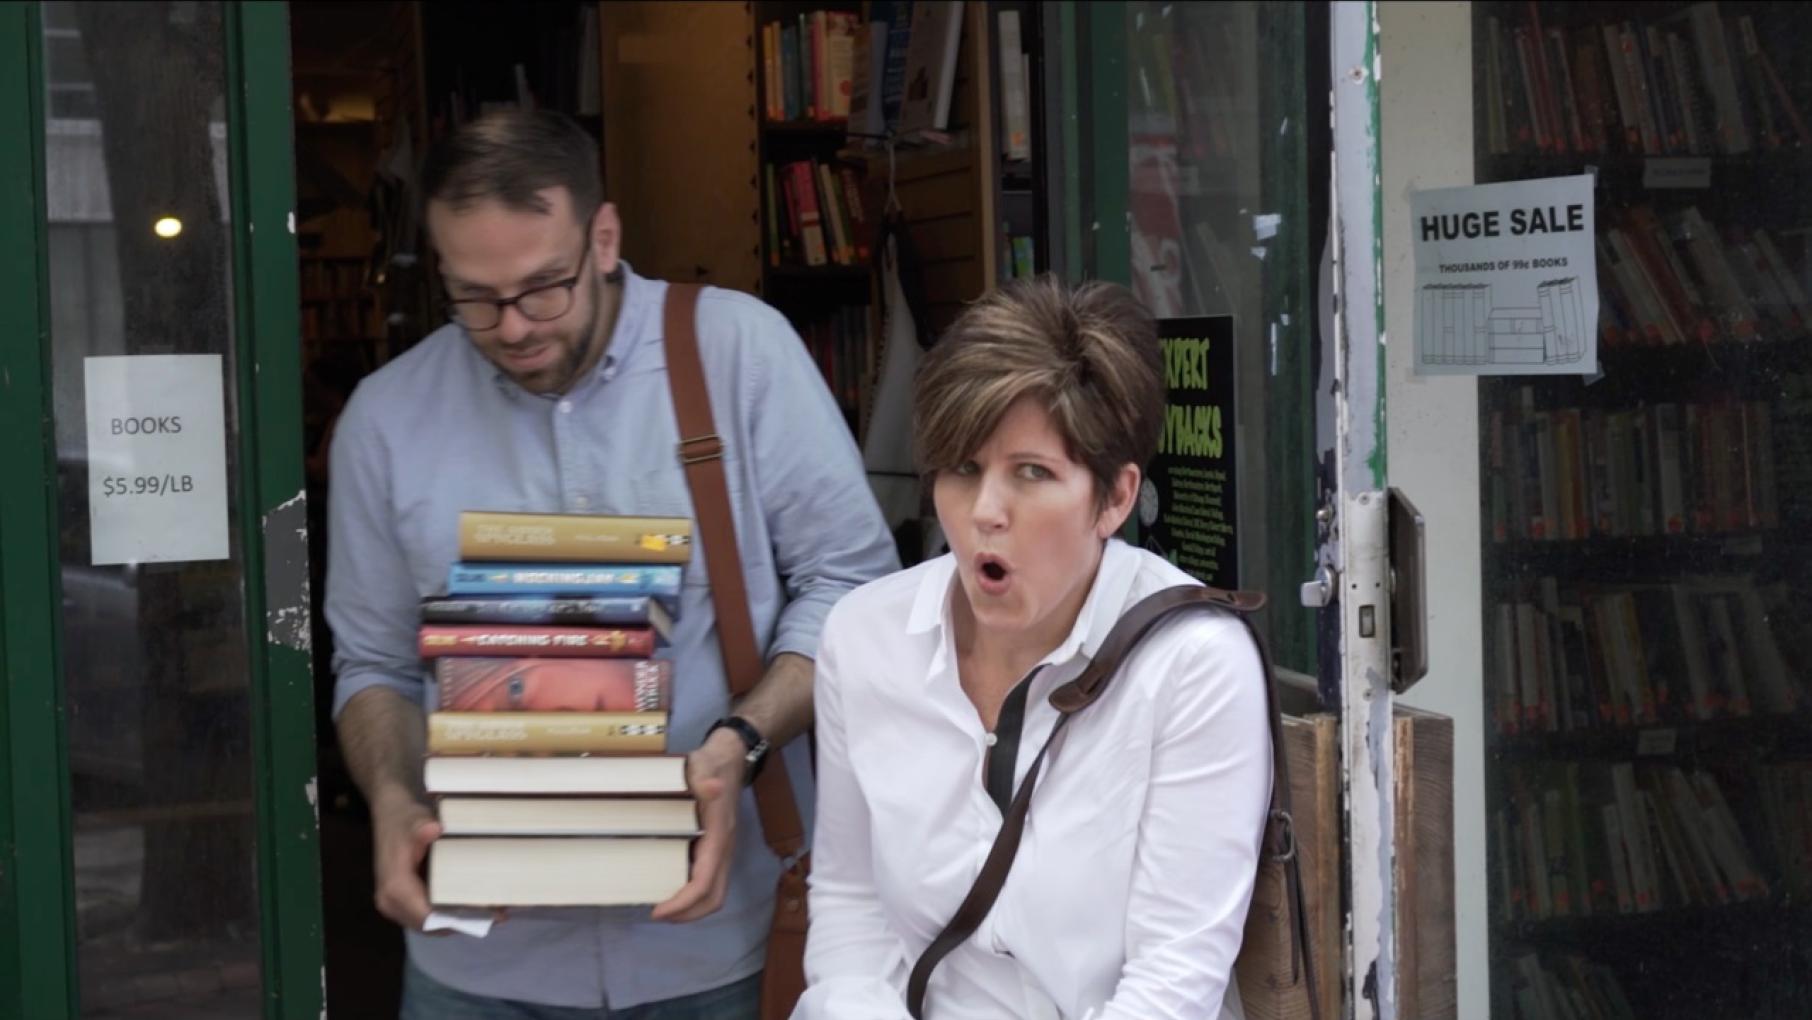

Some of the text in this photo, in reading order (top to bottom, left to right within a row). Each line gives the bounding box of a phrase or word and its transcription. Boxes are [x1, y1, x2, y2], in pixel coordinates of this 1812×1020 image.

[1420, 204, 1585, 242] HUGE SALE
[1438, 261, 1496, 274] THOUSANDS
[1499, 260, 1510, 271] OF
[1532, 257, 1568, 270] BOOKS
[1158, 337, 1211, 390] XPERT
[110, 416, 183, 435] BOOKS
[102, 473, 194, 497] $5.99/LB
[552, 633, 589, 647] FIRE
